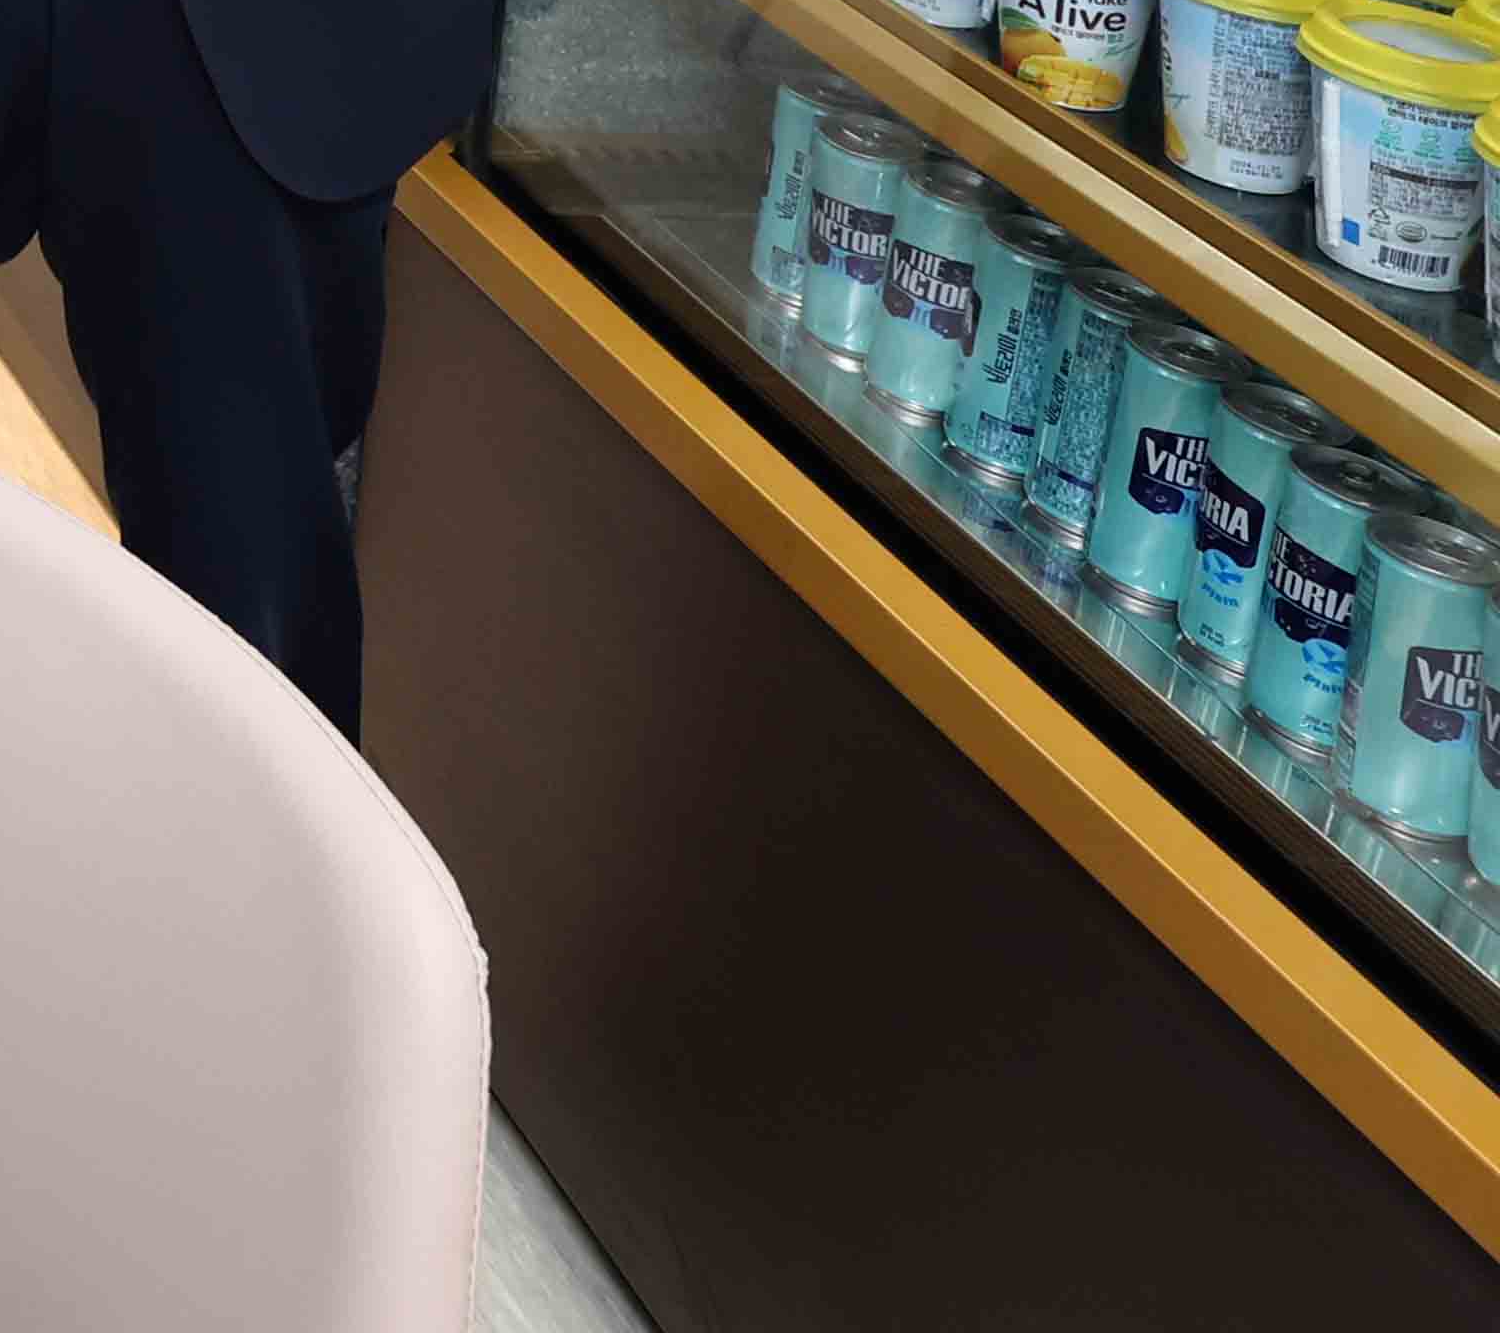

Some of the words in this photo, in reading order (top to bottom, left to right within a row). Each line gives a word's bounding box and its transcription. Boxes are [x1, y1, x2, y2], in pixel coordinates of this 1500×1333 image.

[820, 195, 853, 227] THE
[811, 211, 888, 258] VICTOR
[891, 244, 973, 307] VICTO
[908, 248, 946, 278] THE
[1175, 436, 1209, 464] TH
[1269, 562, 1357, 622] TORIA
[1453, 653, 1484, 679] TH
